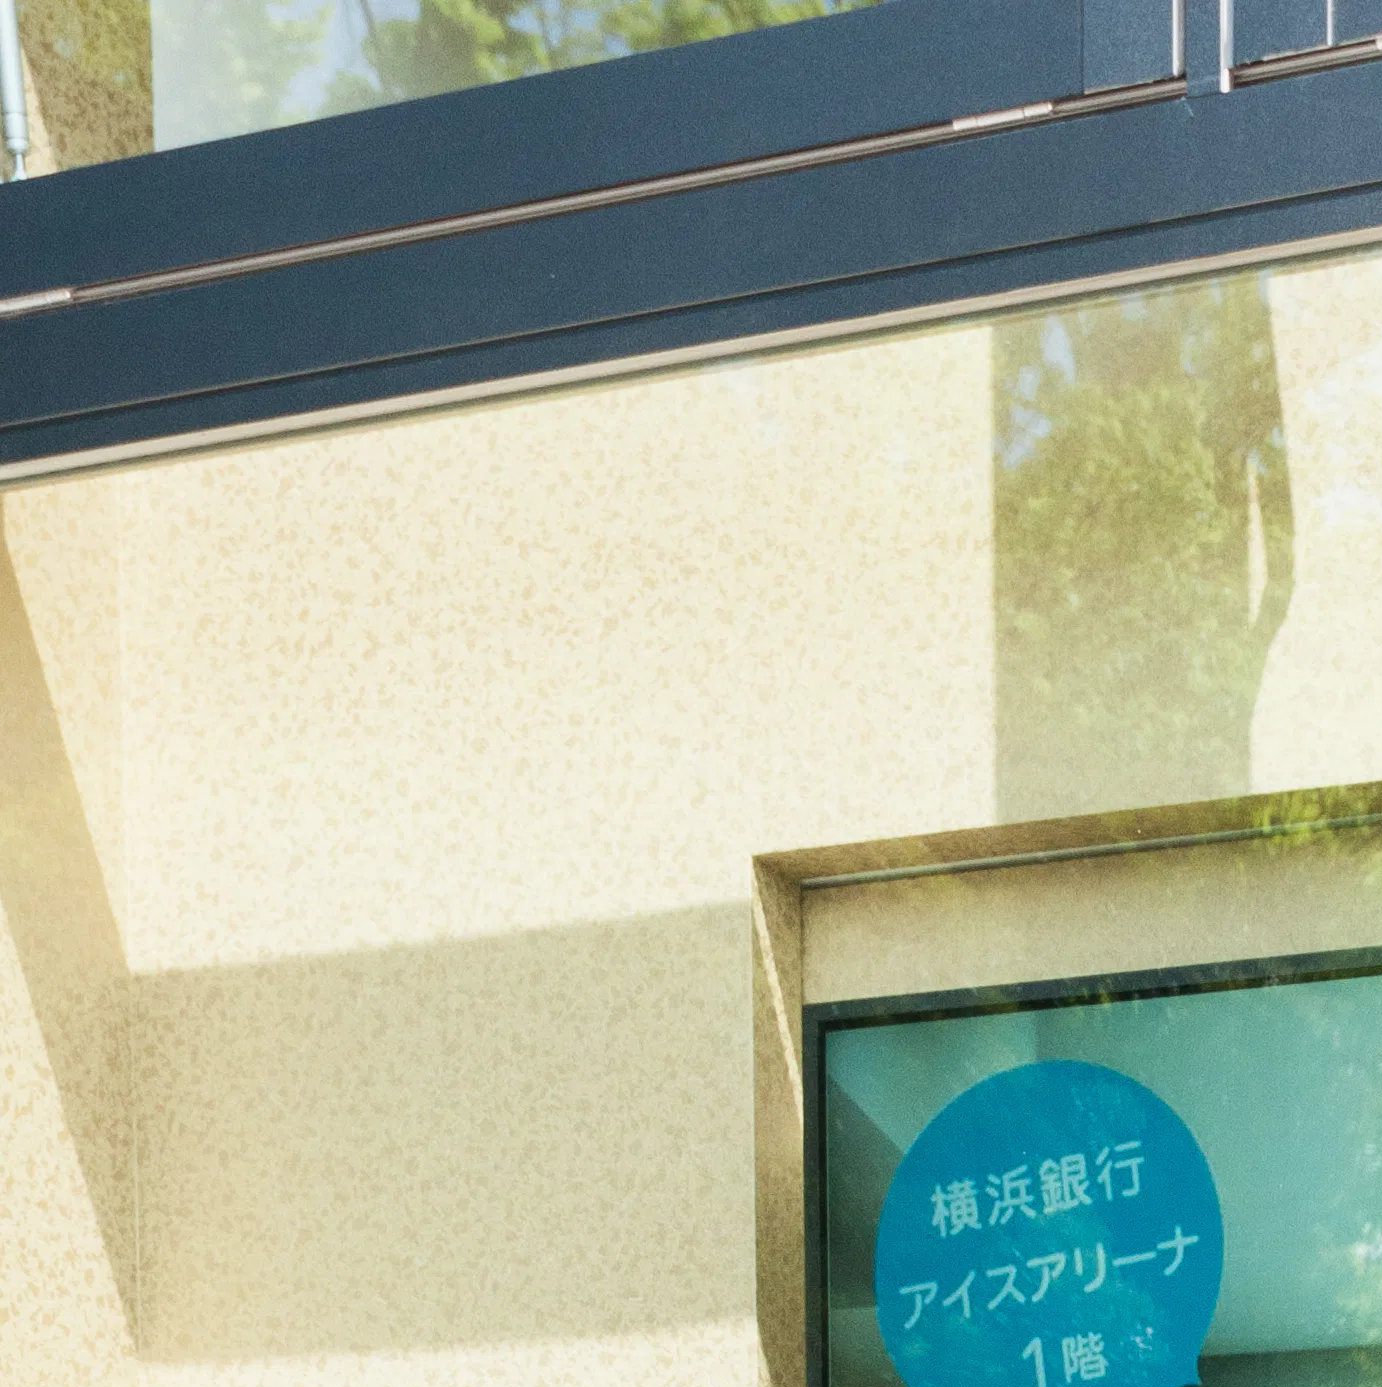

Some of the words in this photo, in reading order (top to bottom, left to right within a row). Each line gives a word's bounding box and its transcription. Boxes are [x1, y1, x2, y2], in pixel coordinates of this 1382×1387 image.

[930, 1139, 1147, 1238] 横浜銀行
[899, 1225, 1199, 1330] アイスアリーナ
